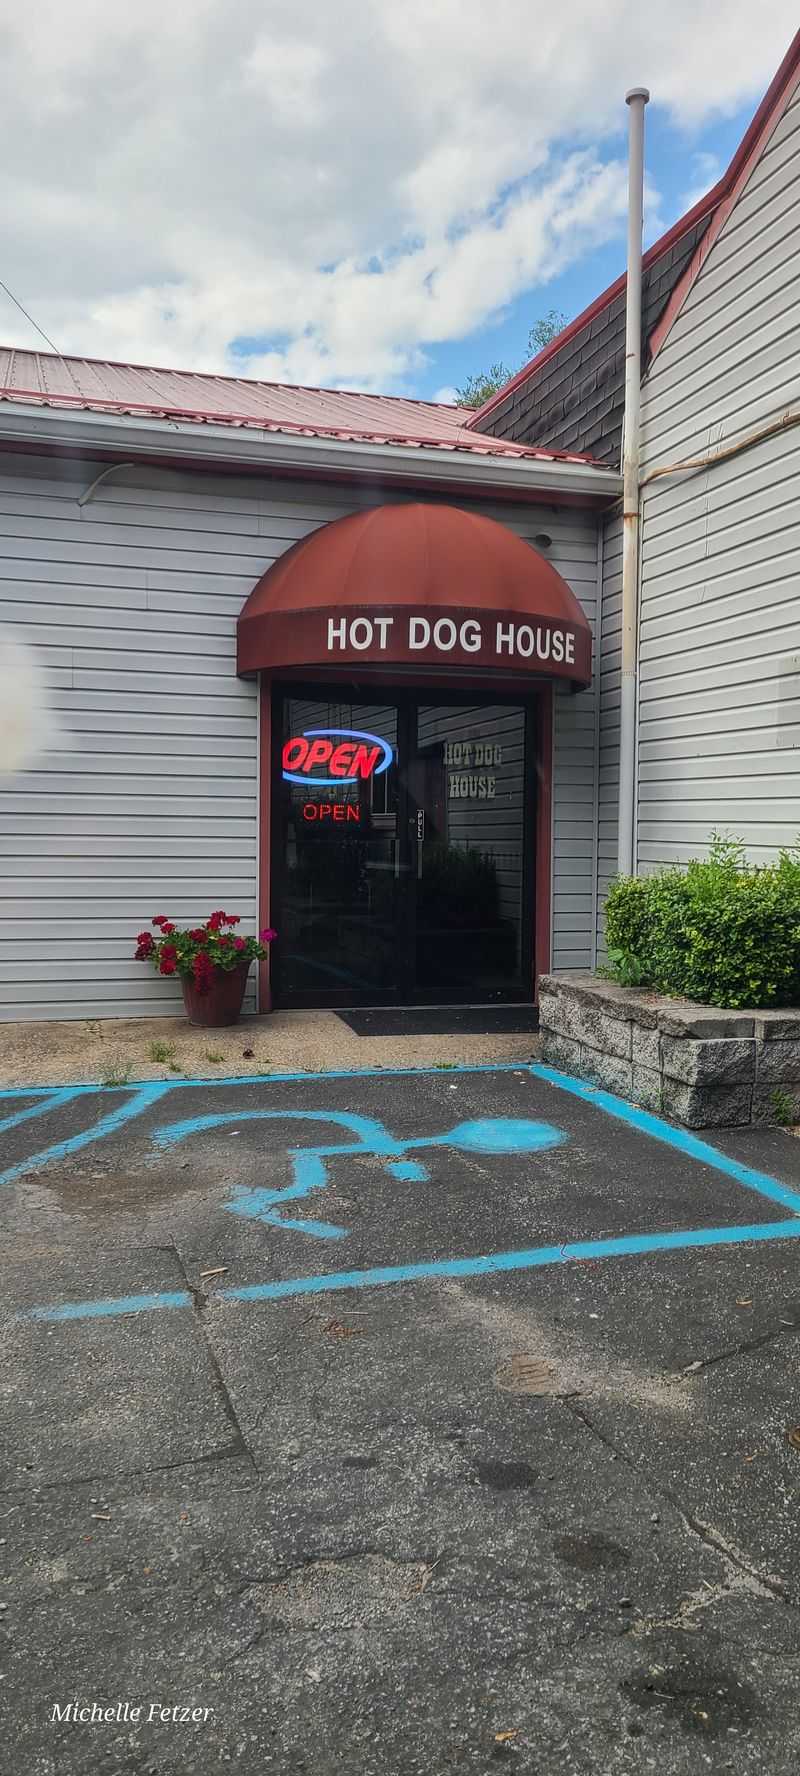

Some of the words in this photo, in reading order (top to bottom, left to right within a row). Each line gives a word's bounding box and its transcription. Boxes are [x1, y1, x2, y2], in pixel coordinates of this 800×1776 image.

[327, 618, 394, 650] HOT
[408, 616, 482, 652] DOG
[496, 622, 576, 664] HOUSE
[282, 737, 381, 779] OPEN
[443, 742, 473, 766] HOT
[475, 743, 503, 766] DOG
[449, 775, 496, 799] HOUSE
[302, 803, 360, 822] OPEN
